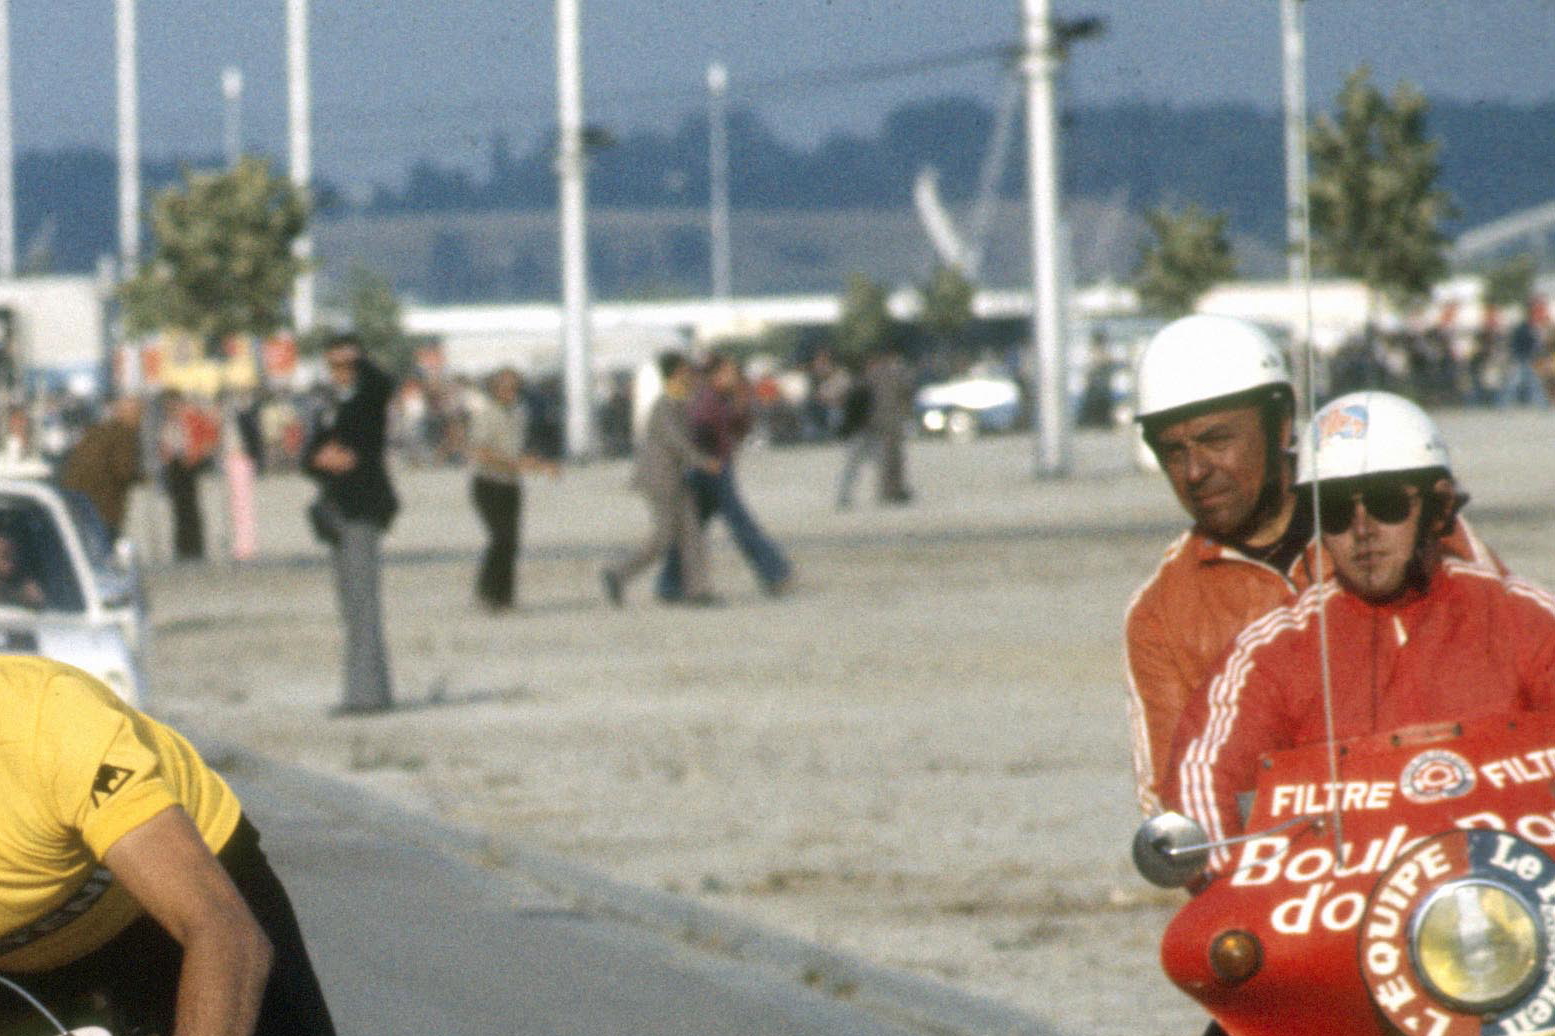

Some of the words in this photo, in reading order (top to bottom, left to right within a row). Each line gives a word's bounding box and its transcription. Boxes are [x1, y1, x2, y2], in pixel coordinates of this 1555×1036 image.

[1270, 780, 1397, 818] FILTRE
[1230, 825, 1429, 887] Boul
[1489, 834, 1543, 881] Le
